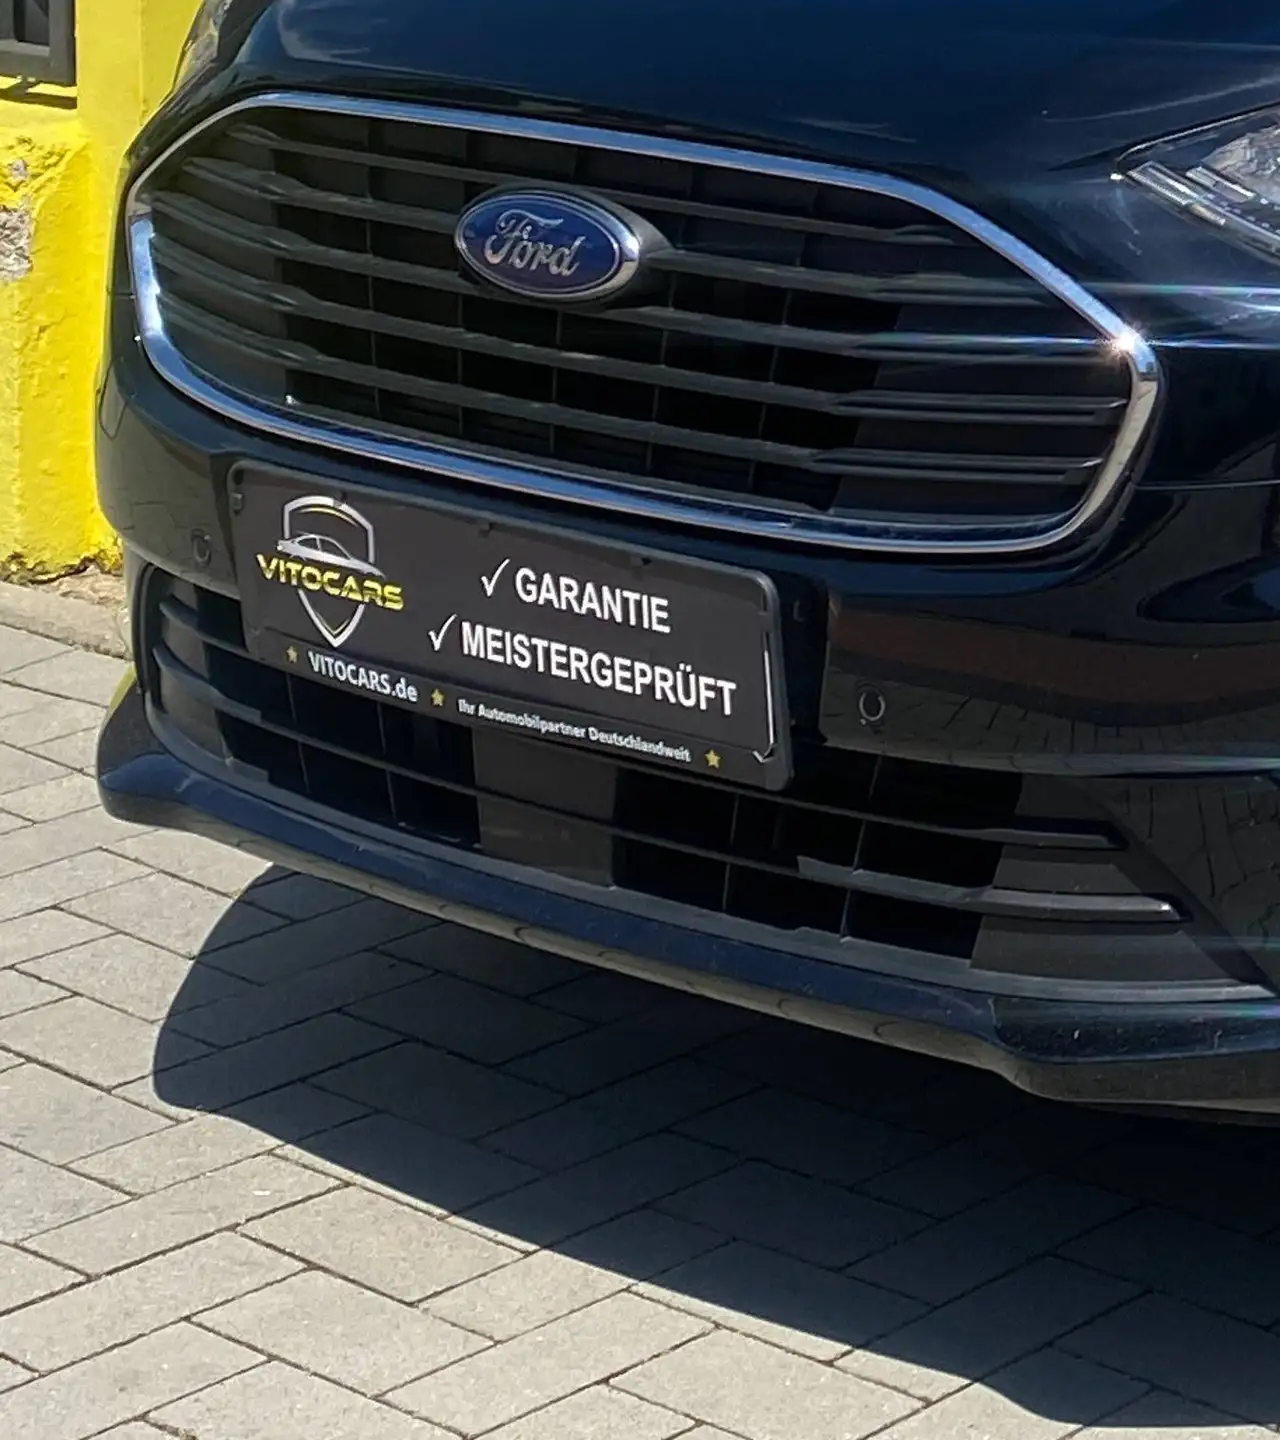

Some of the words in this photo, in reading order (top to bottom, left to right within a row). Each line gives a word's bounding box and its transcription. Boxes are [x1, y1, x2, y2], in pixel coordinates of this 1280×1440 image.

[485, 208, 586, 277] Ford
[256, 553, 405, 611] VITOCARS
[514, 566, 672, 634] GARANTIE
[307, 649, 419, 703] VITOCARS.de
[460, 621, 738, 717] MEISTERGEPRÜFT
[457, 698, 476, 716] Ihr
[477, 703, 587, 740] Automobilpartner
[588, 725, 692, 762] Deutschlandweit
